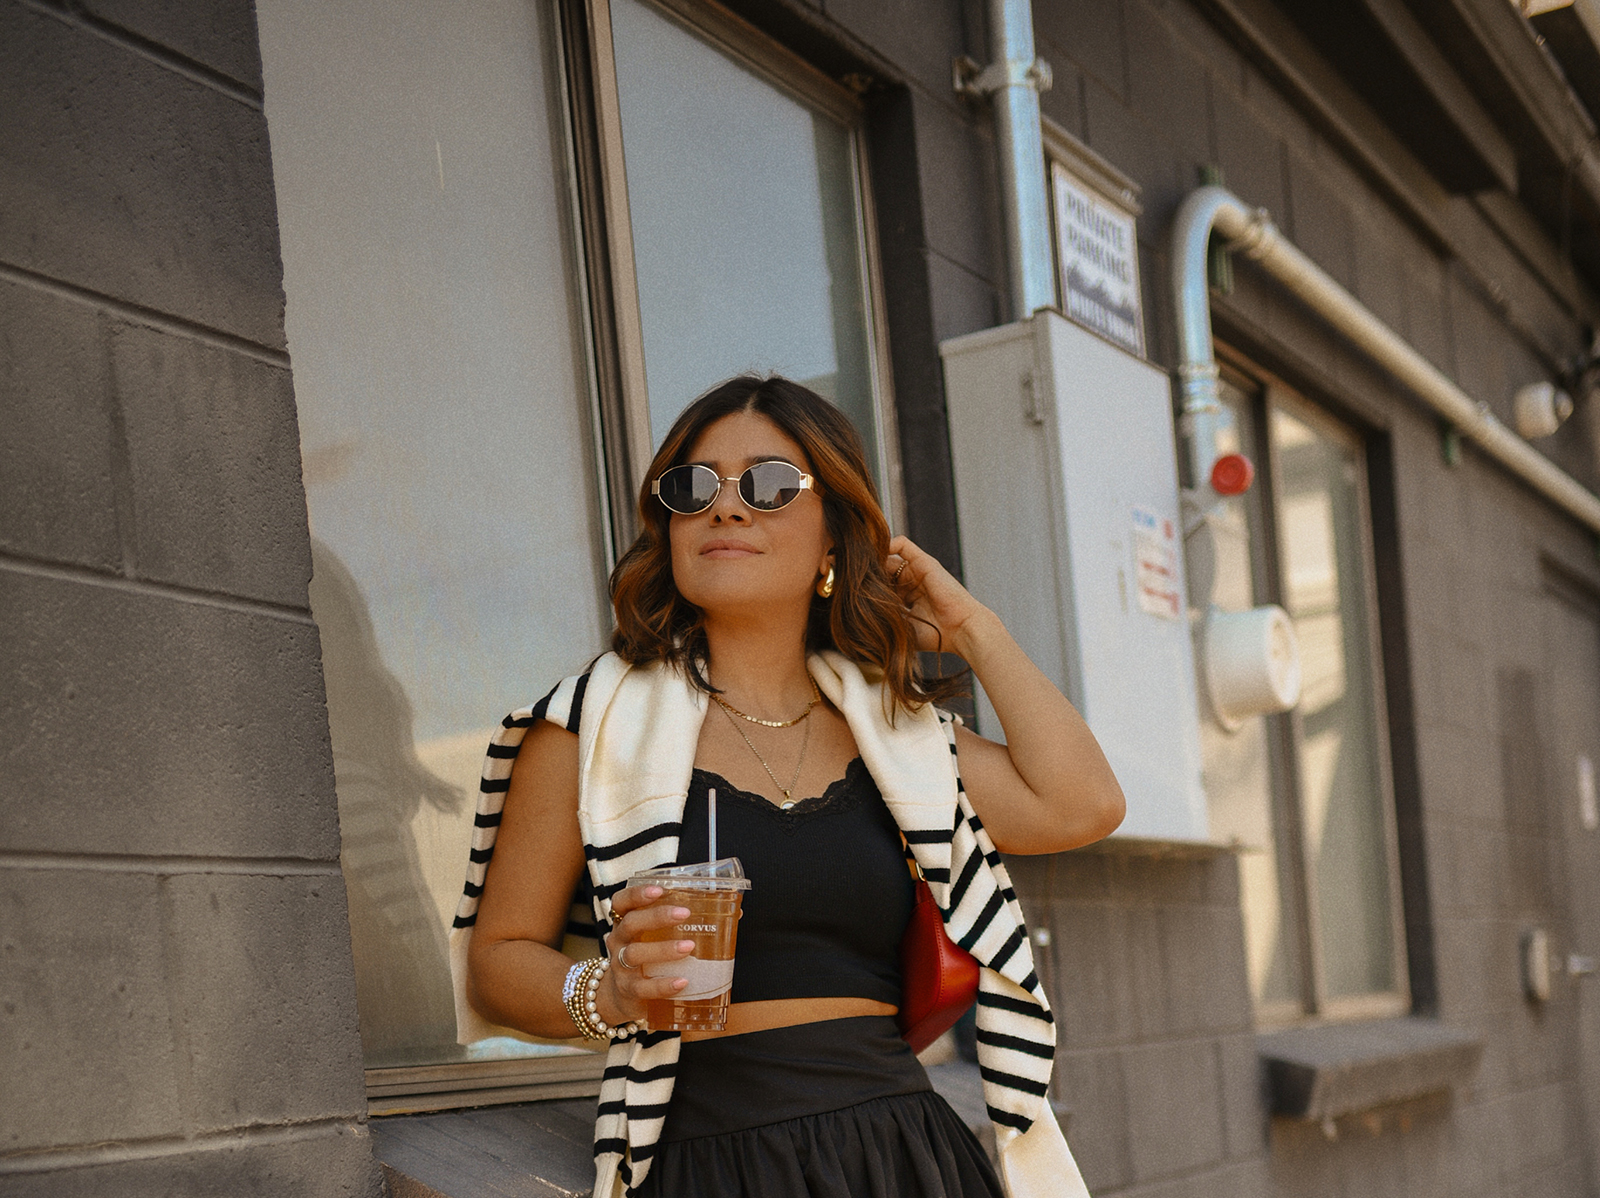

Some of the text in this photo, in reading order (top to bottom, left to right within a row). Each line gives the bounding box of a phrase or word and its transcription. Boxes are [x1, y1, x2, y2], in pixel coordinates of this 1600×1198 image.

[1066, 190, 1124, 251] PRIVATE
[1067, 224, 1129, 285] PARKING
[677, 924, 717, 932] CORVUS
